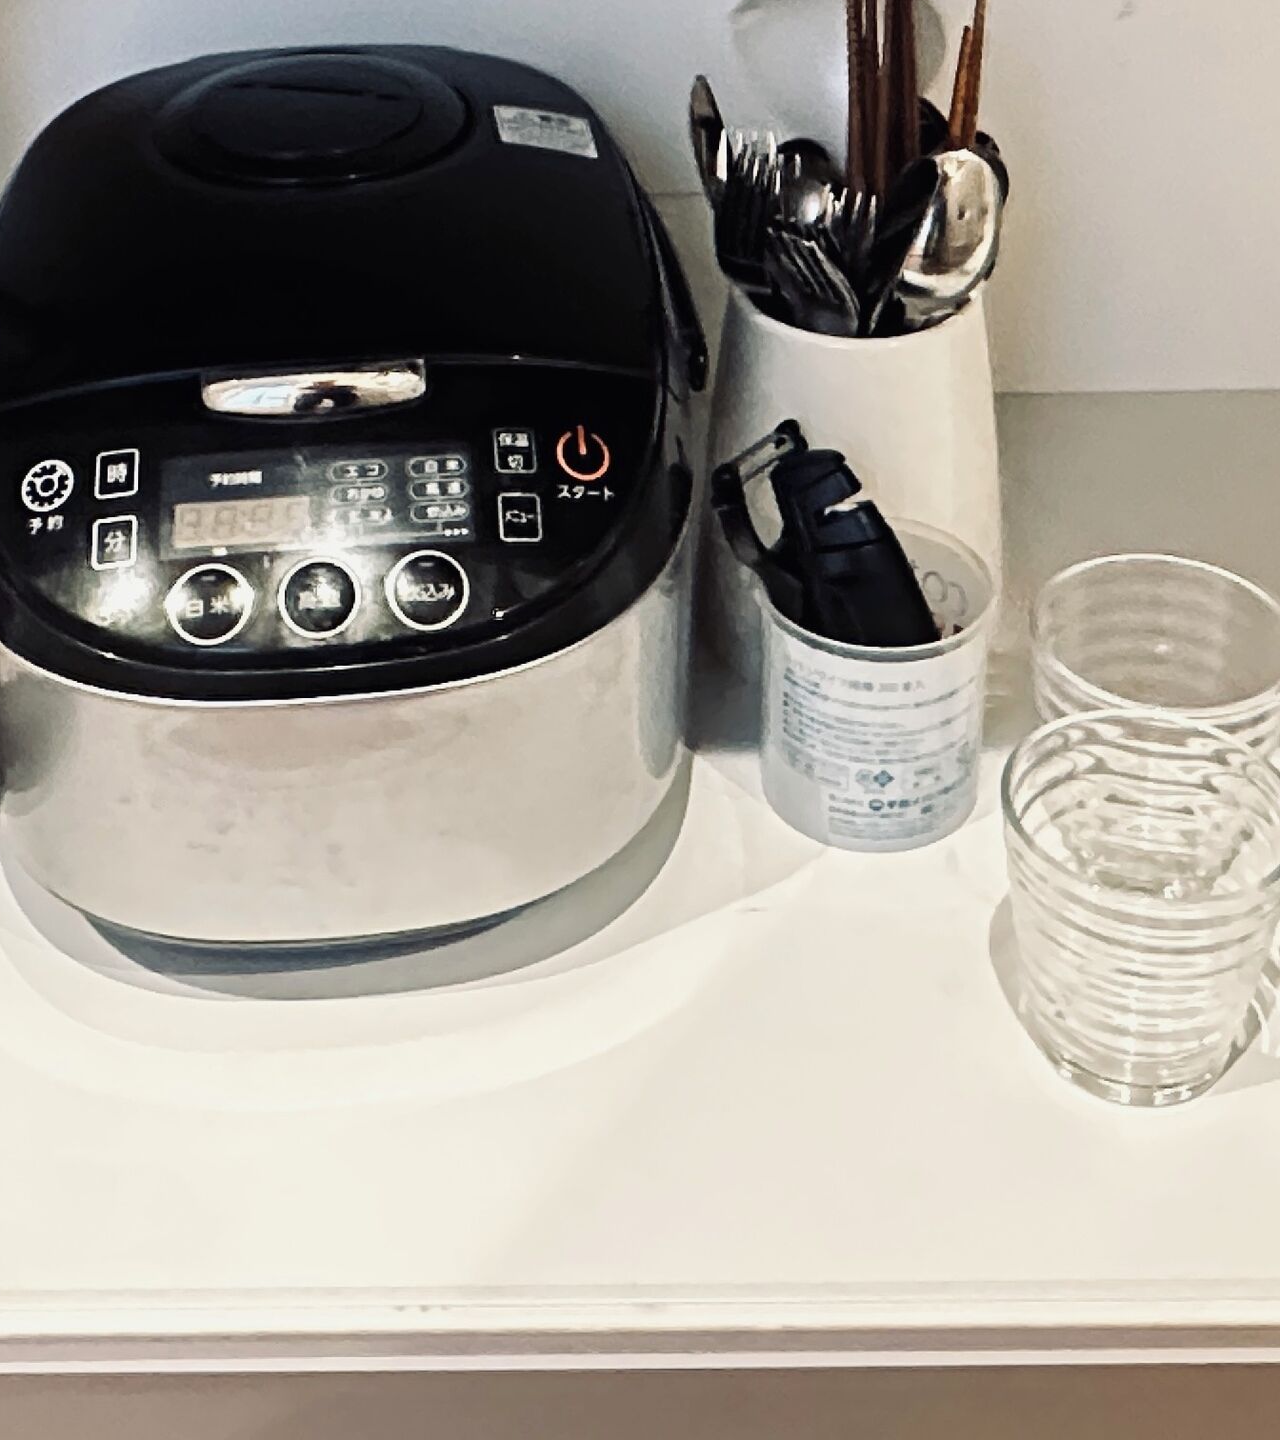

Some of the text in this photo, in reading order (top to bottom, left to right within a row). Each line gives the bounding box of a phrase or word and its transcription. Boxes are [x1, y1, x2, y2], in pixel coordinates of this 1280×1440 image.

[557, 484, 614, 501] スタート
[103, 528, 126, 553] 分
[185, 595, 230, 619] 白米
